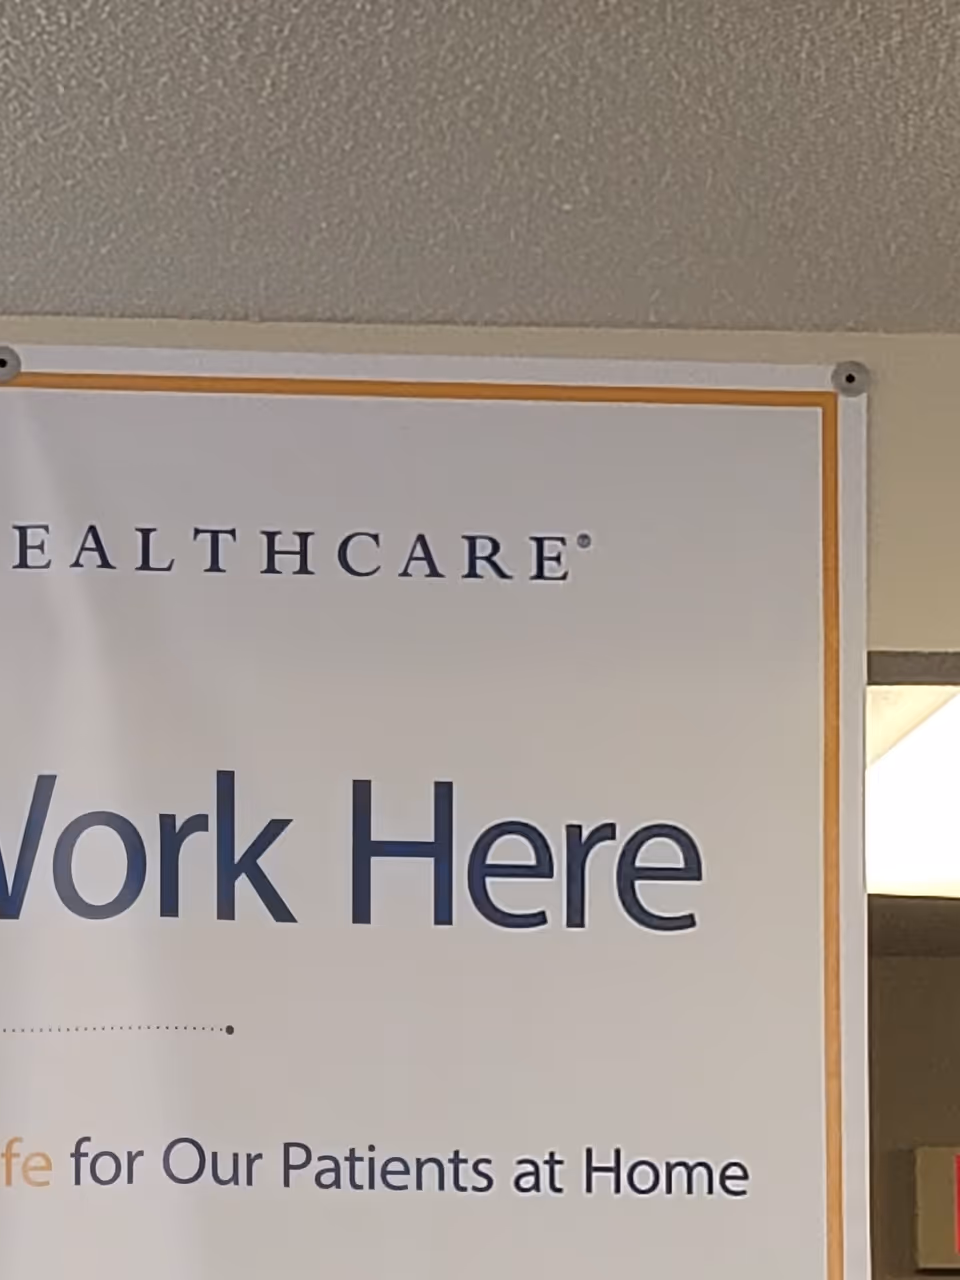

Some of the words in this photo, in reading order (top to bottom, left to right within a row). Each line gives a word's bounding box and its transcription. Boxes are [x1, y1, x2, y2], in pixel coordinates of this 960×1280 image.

[352, 779, 703, 932] Here
[70, 1136, 145, 1186] for
[162, 1137, 263, 1187] Our
[283, 1141, 494, 1193] Patients
[513, 1150, 565, 1194] at
[585, 1146, 750, 1198] Home
